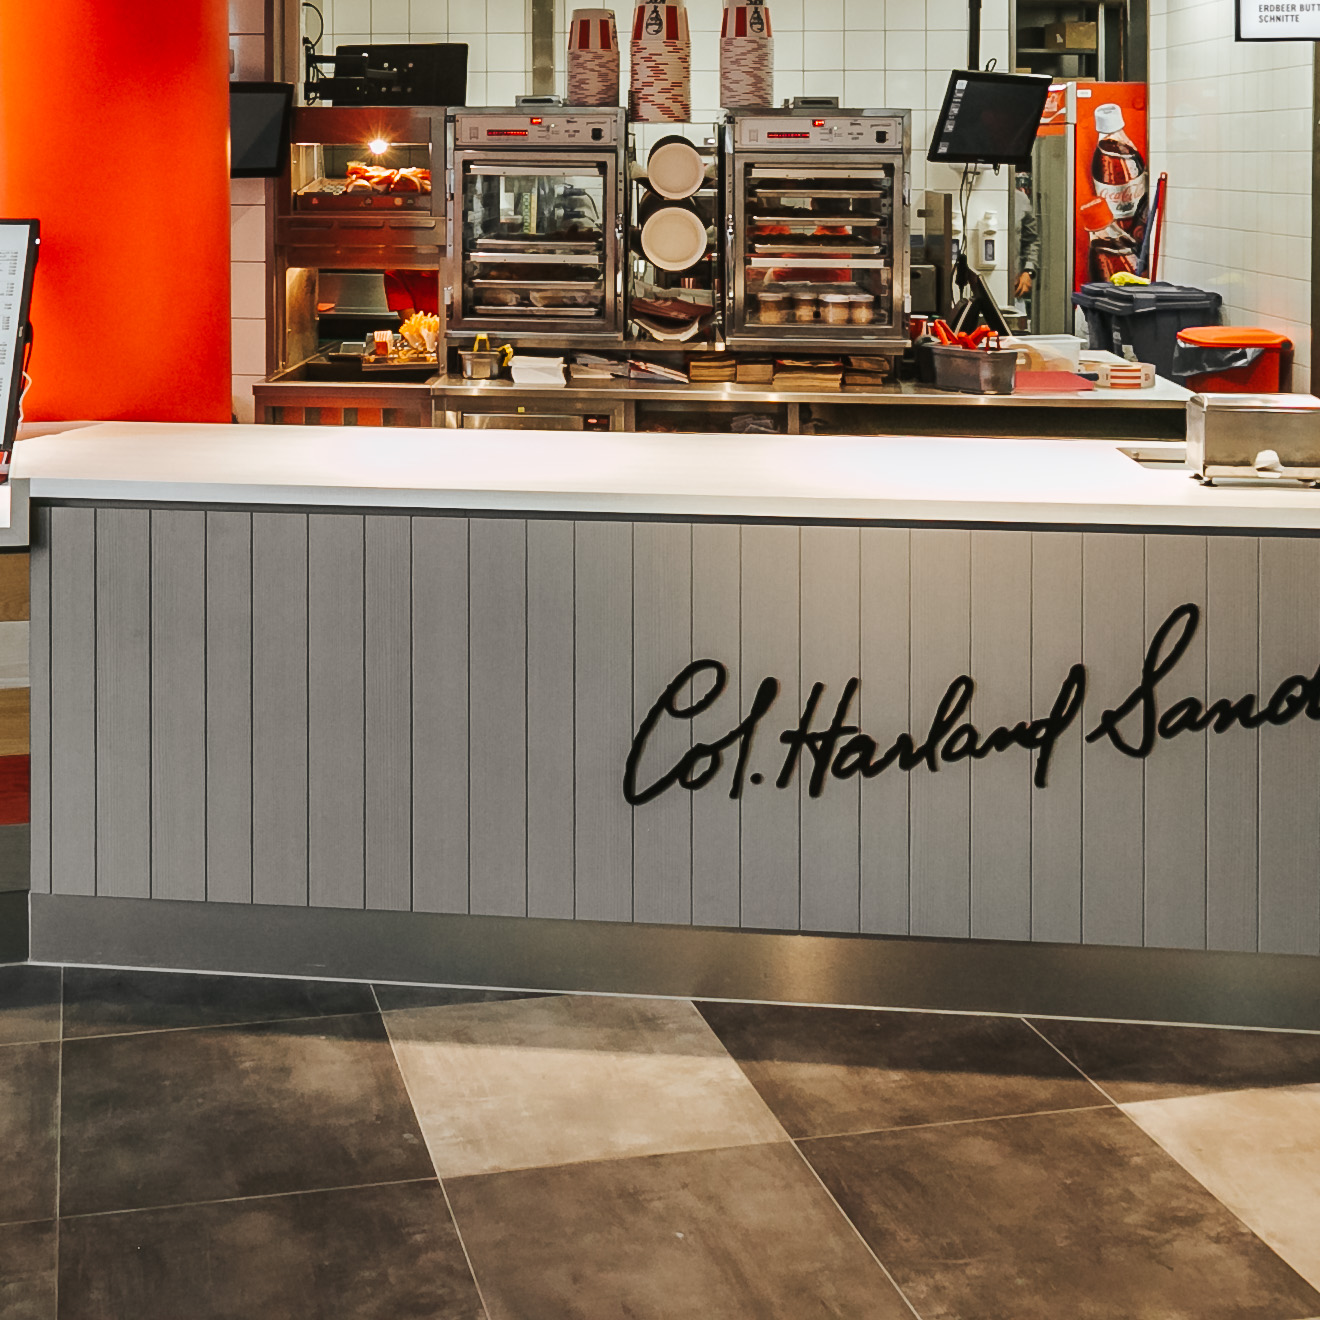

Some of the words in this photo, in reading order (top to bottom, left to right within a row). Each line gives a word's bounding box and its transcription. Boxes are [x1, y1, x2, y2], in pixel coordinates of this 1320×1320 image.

[1258, 4, 1297, 13] ERDBEER
[1258, 14, 1300, 23] SCHNITTE
[623, 659, 781, 806] Col.
[777, 664, 1086, 798] Harland
